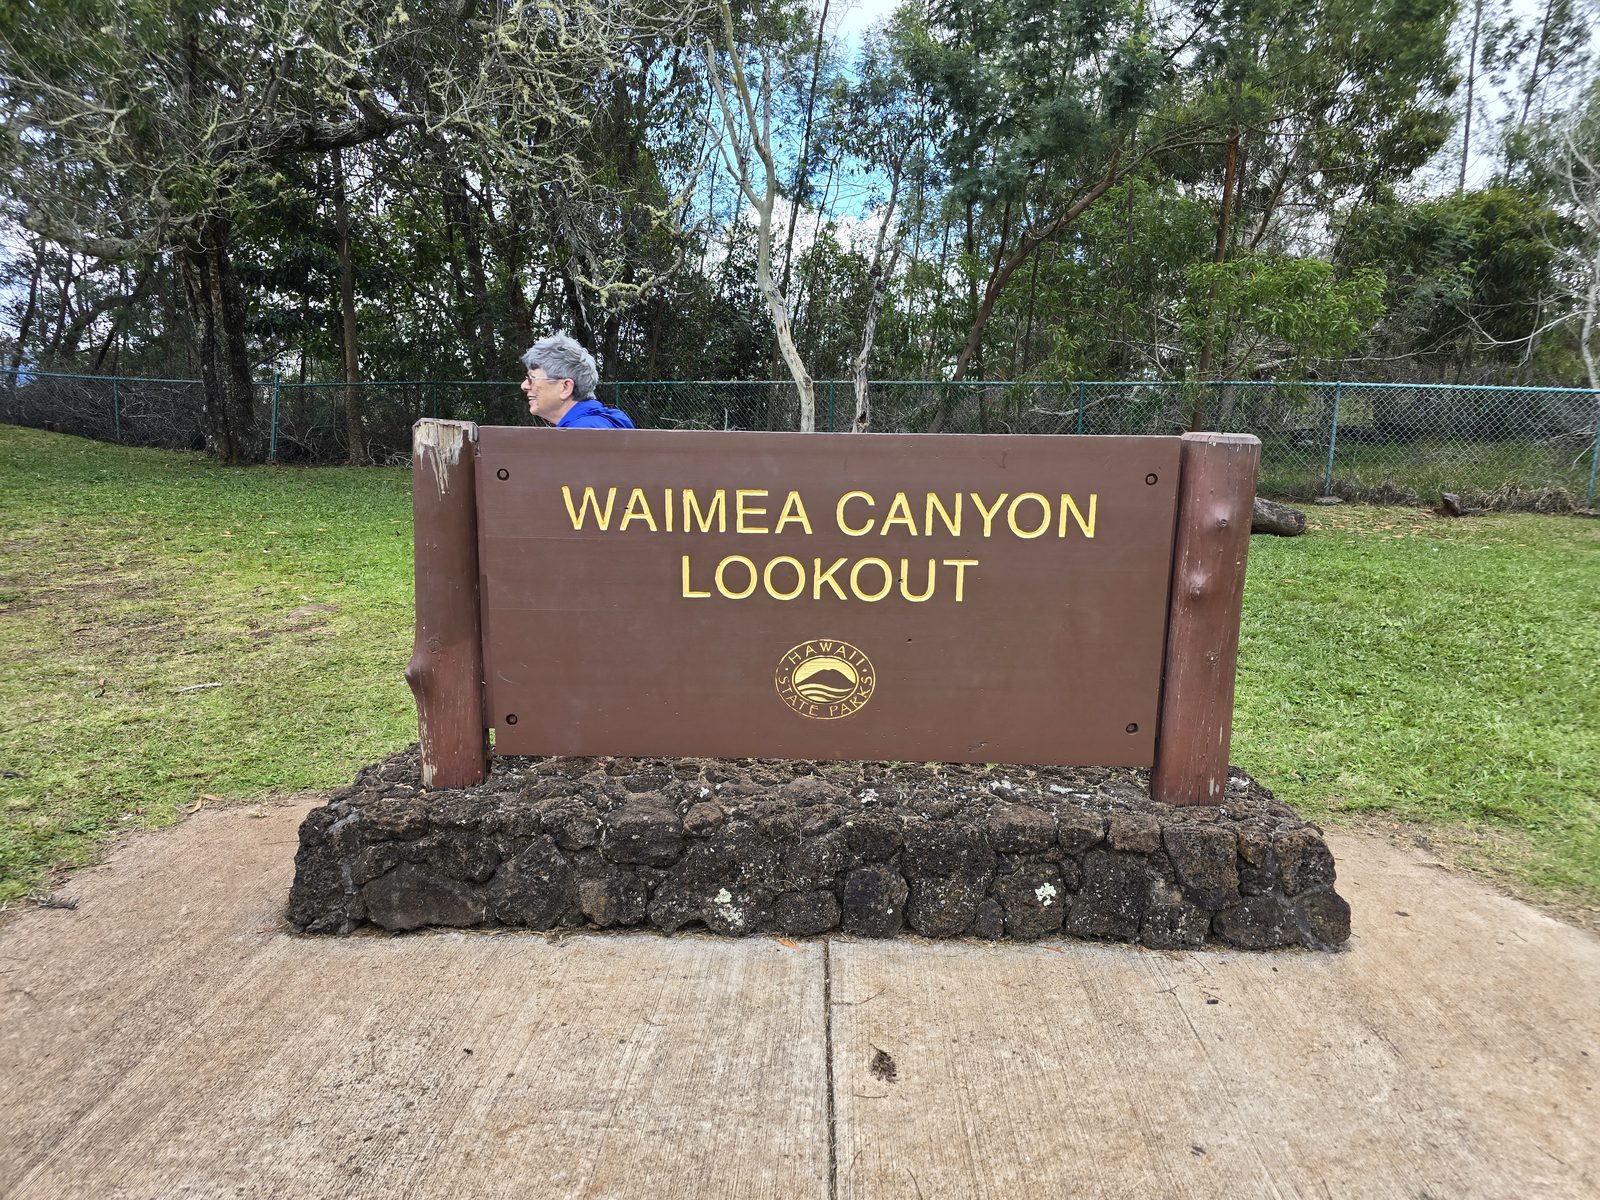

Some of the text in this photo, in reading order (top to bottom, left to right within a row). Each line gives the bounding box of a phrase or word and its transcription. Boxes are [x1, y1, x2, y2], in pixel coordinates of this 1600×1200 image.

[561, 485, 1098, 539] WAIMEA CANYON
[680, 554, 979, 603] LOOKOUT
[788, 642, 865, 667] HAWAII
[778, 675, 873, 716] STATE PARKS
